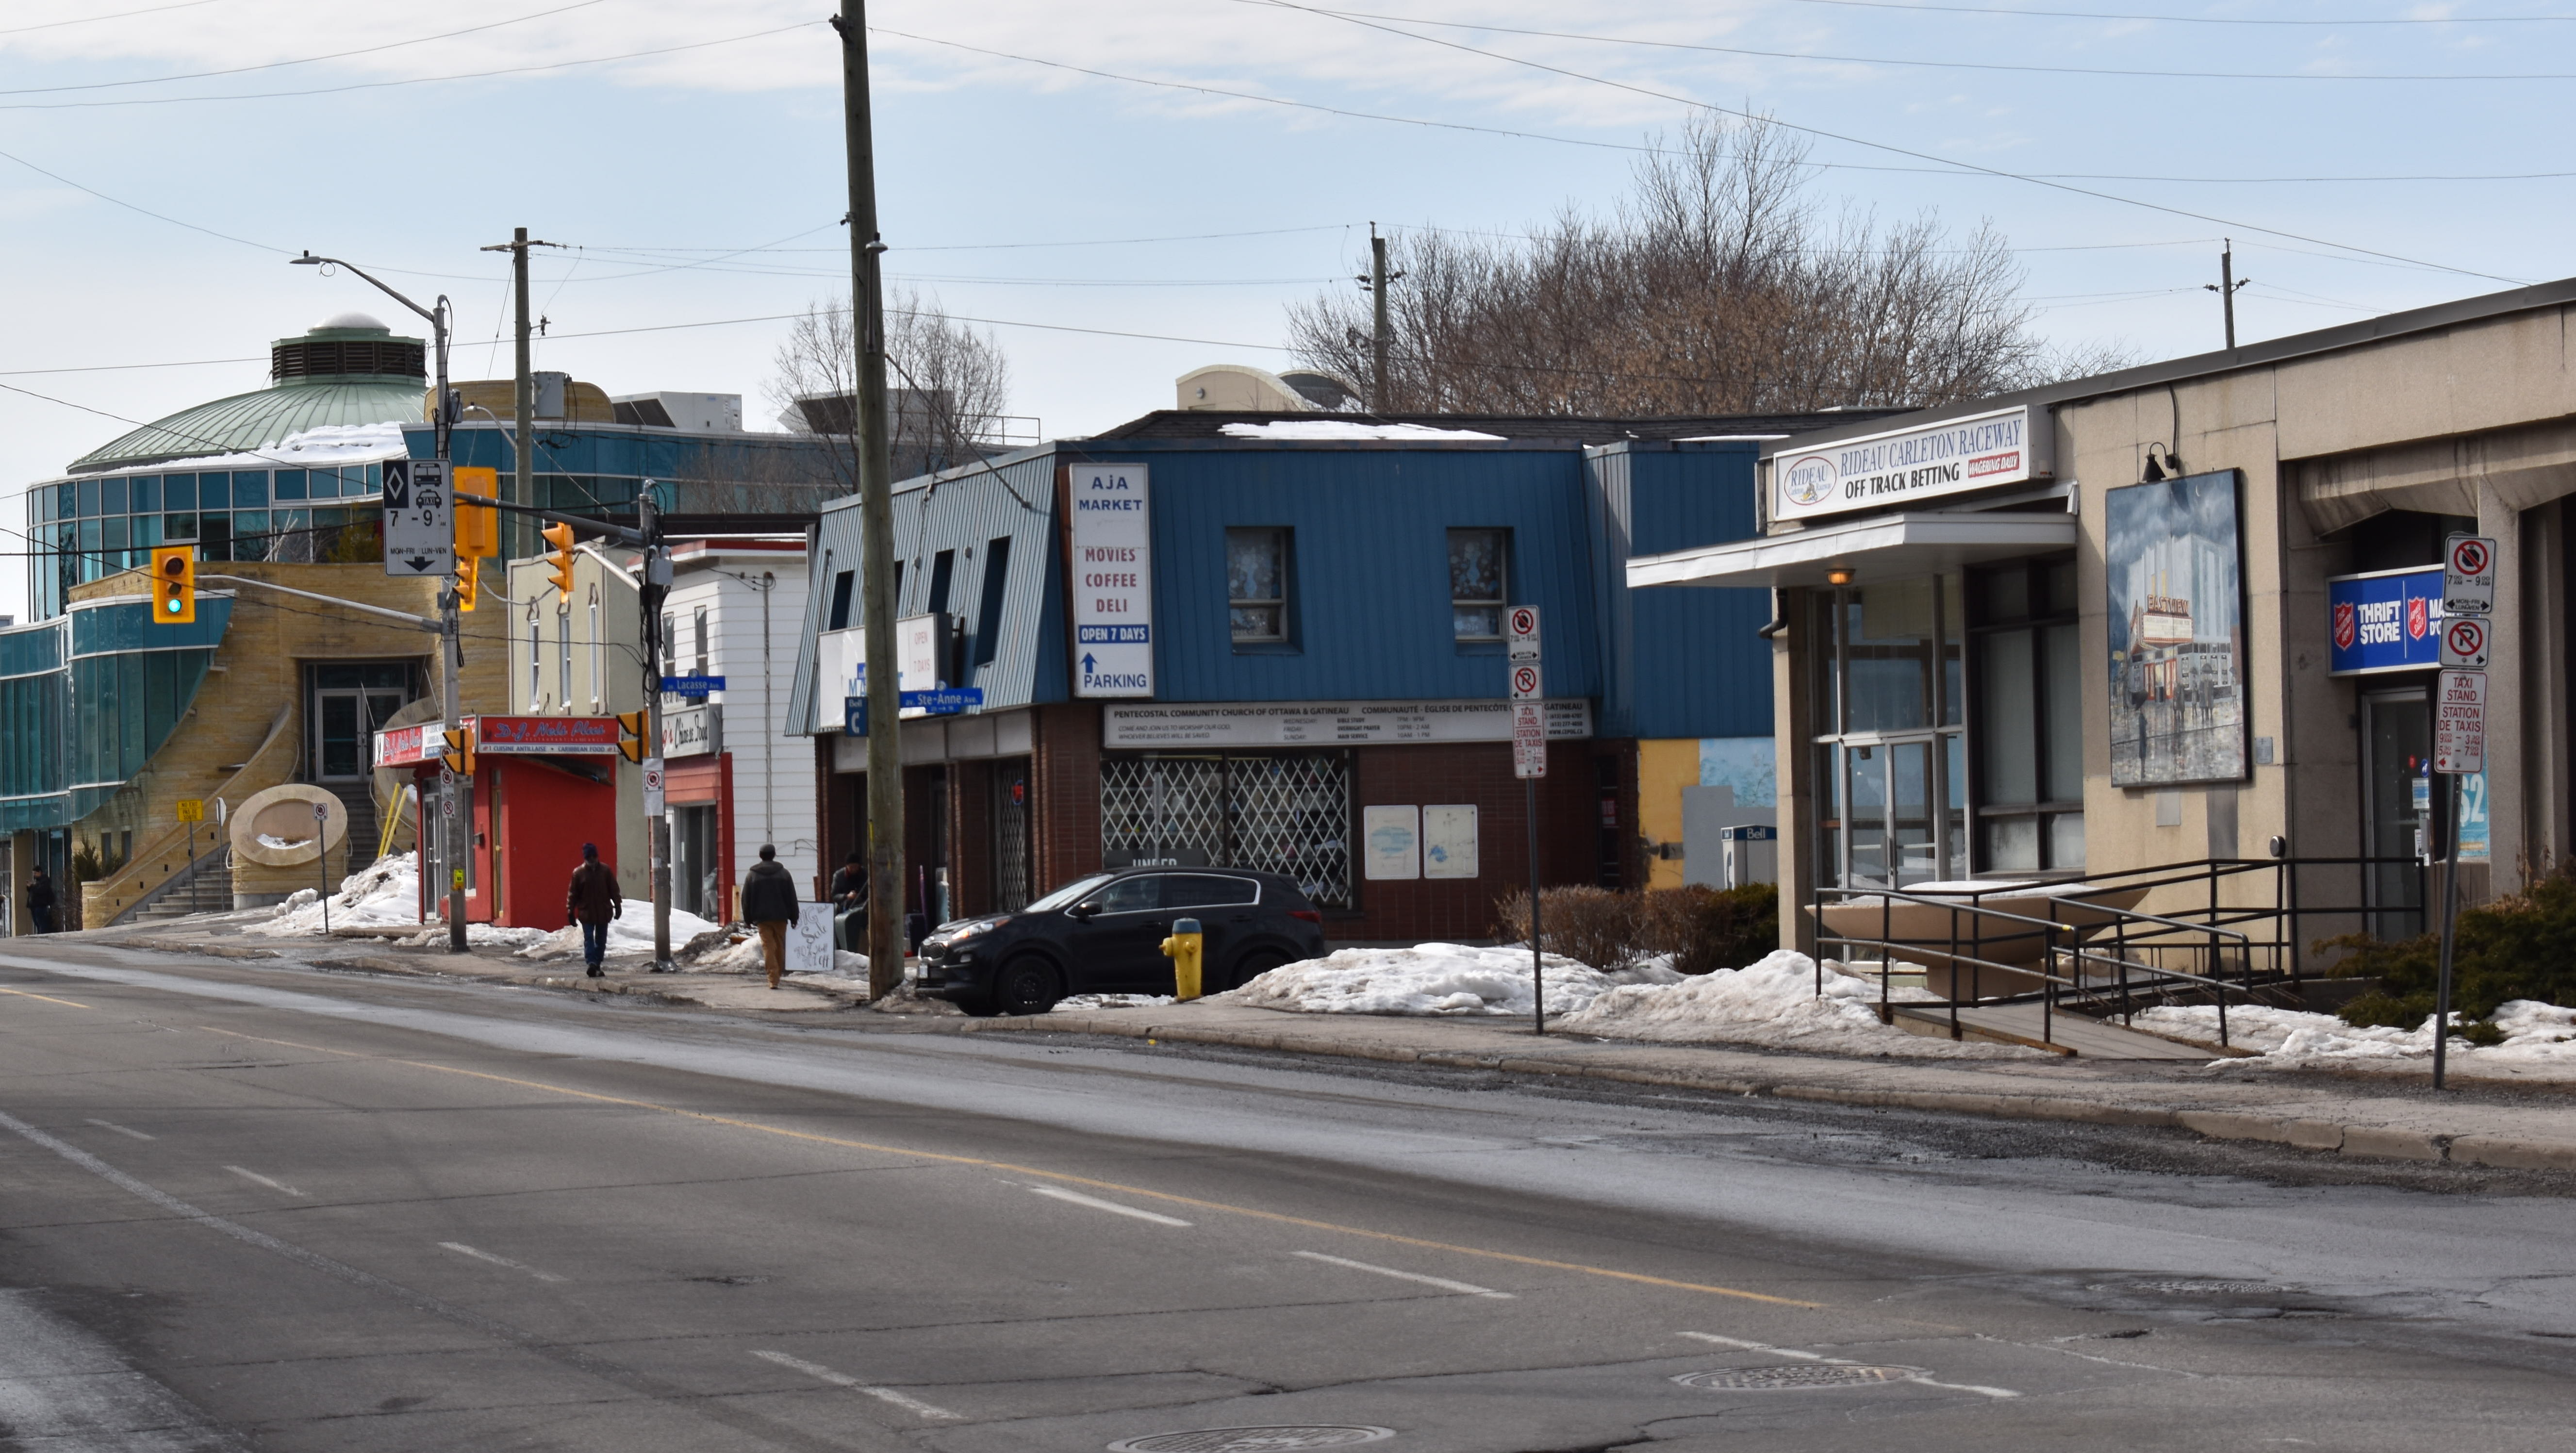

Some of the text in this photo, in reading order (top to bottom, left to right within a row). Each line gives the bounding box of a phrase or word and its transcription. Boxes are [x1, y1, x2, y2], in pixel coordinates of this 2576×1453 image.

[1841, 419, 2021, 477] RIDEAU CARLETON RACEWAY
[1969, 458, 2000, 475] WAGERING
[1791, 464, 1828, 486] RIDEAU
[1845, 462, 1959, 499] OFF TRACK BETTING
[423, 496, 435, 506] TAXI
[1079, 499, 1142, 510] MARKET
[390, 511, 398, 527] 7
[423, 510, 432, 527] 9
[1085, 548, 1136, 562] MOVIES
[1086, 574, 1137, 587] COFFEE
[2448, 575, 2453, 585] 7
[2476, 576, 2480, 586] 9
[1096, 598, 1127, 612] DELI
[2147, 594, 2189, 614] EASTVIEW
[2358, 600, 2401, 624] THRIFT
[914, 631, 928, 645] OPEN
[1081, 627, 1146, 641] OPEN 7 DAYS
[2360, 621, 2400, 644] STORE
[918, 659, 930, 673] DAYS
[677, 680, 708, 690] Lacasse
[1084, 674, 1147, 688] PARKING
[2453, 677, 2473, 689] TAXI
[917, 693, 961, 706] Ste-Anne
[2447, 689, 2477, 701] STAND
[1114, 710, 1169, 718] PENTECOSTAL
[1171, 709, 1220, 717] COMMUNITY
[1362, 705, 1419, 714] COMMUNAUTÉ
[1425, 704, 1452, 713] ÉGLISE
[1464, 704, 1508, 712] PENTECÔTE
[1521, 708, 1534, 716] TAXI
[2443, 706, 2480, 719] STATION
[1518, 717, 1537, 726] STAND
[2439, 720, 2481, 732] DE TAXIS
[495, 722, 530, 742] D.J.
[571, 720, 606, 737] Plus
[675, 716, 694, 749] Chinese
[1516, 729, 1540, 738] STATION
[1515, 738, 1542, 748] DE TAXIS
[2439, 733, 2444, 743] 9
[2465, 734, 2470, 744] 3
[2438, 745, 2443, 756] 5
[2465, 746, 2469, 757] 7
[1747, 827, 1766, 839] Bell
